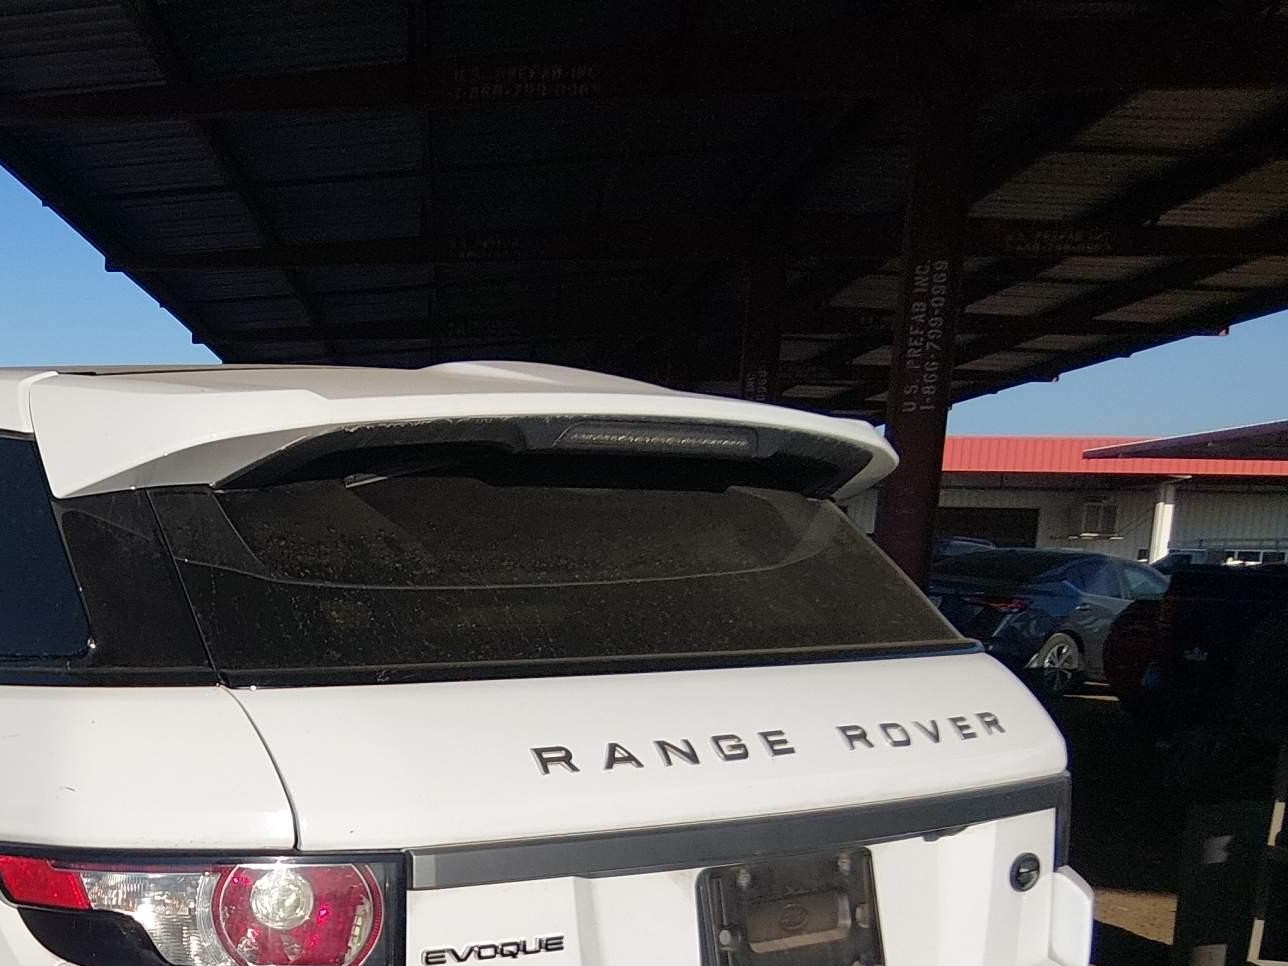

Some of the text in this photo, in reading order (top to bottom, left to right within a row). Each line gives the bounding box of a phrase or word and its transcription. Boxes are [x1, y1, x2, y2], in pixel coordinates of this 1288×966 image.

[913, 259, 932, 293] INC.
[905, 302, 927, 370] PREFAB
[532, 711, 1006, 775] RANGE ROVER
[421, 935, 565, 966] EVOQUE
